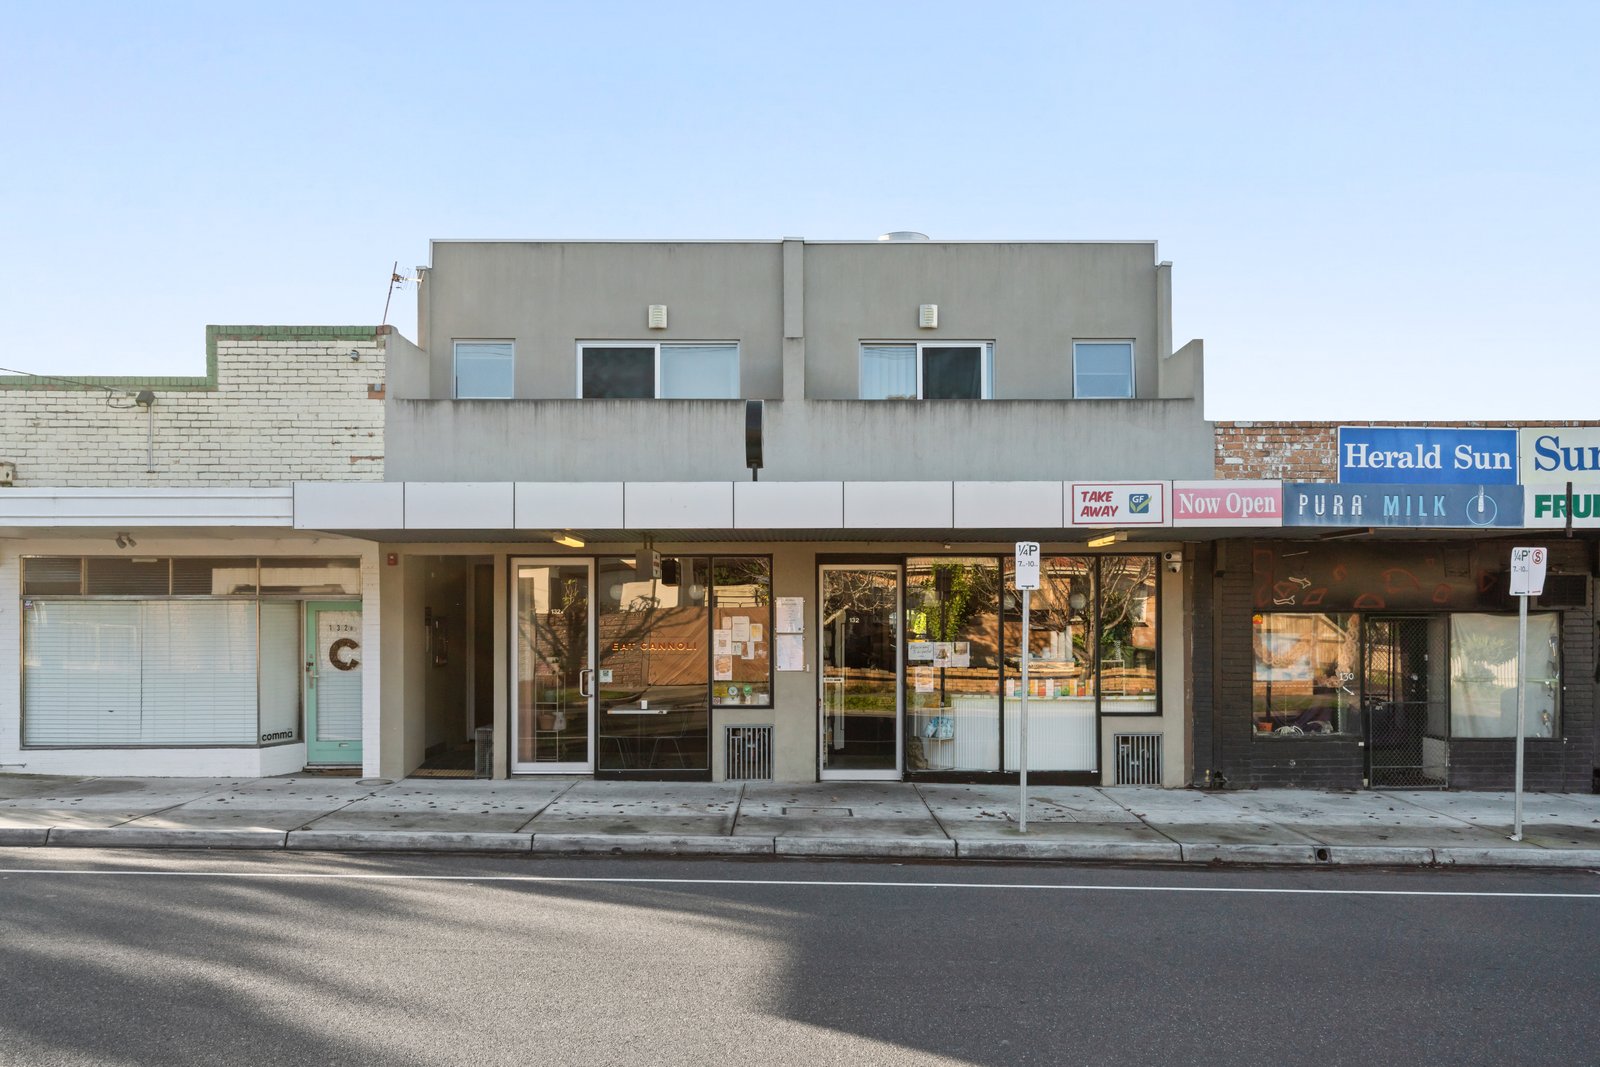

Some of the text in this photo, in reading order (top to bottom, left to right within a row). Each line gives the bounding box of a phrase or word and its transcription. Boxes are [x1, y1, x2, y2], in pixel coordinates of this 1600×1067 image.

[1344, 442, 1512, 470] Herald Sun
[1081, 490, 1114, 504] TAKE
[1131, 495, 1144, 504] GF
[1080, 504, 1119, 518] AWAY
[1179, 492, 1276, 518] Now Open
[1298, 494, 1446, 517] PURA MILK
[612, 641, 697, 651] EAT CANNOLI
[328, 637, 360, 672] C
[1339, 672, 1354, 682] 130
[261, 730, 293, 742] comma
